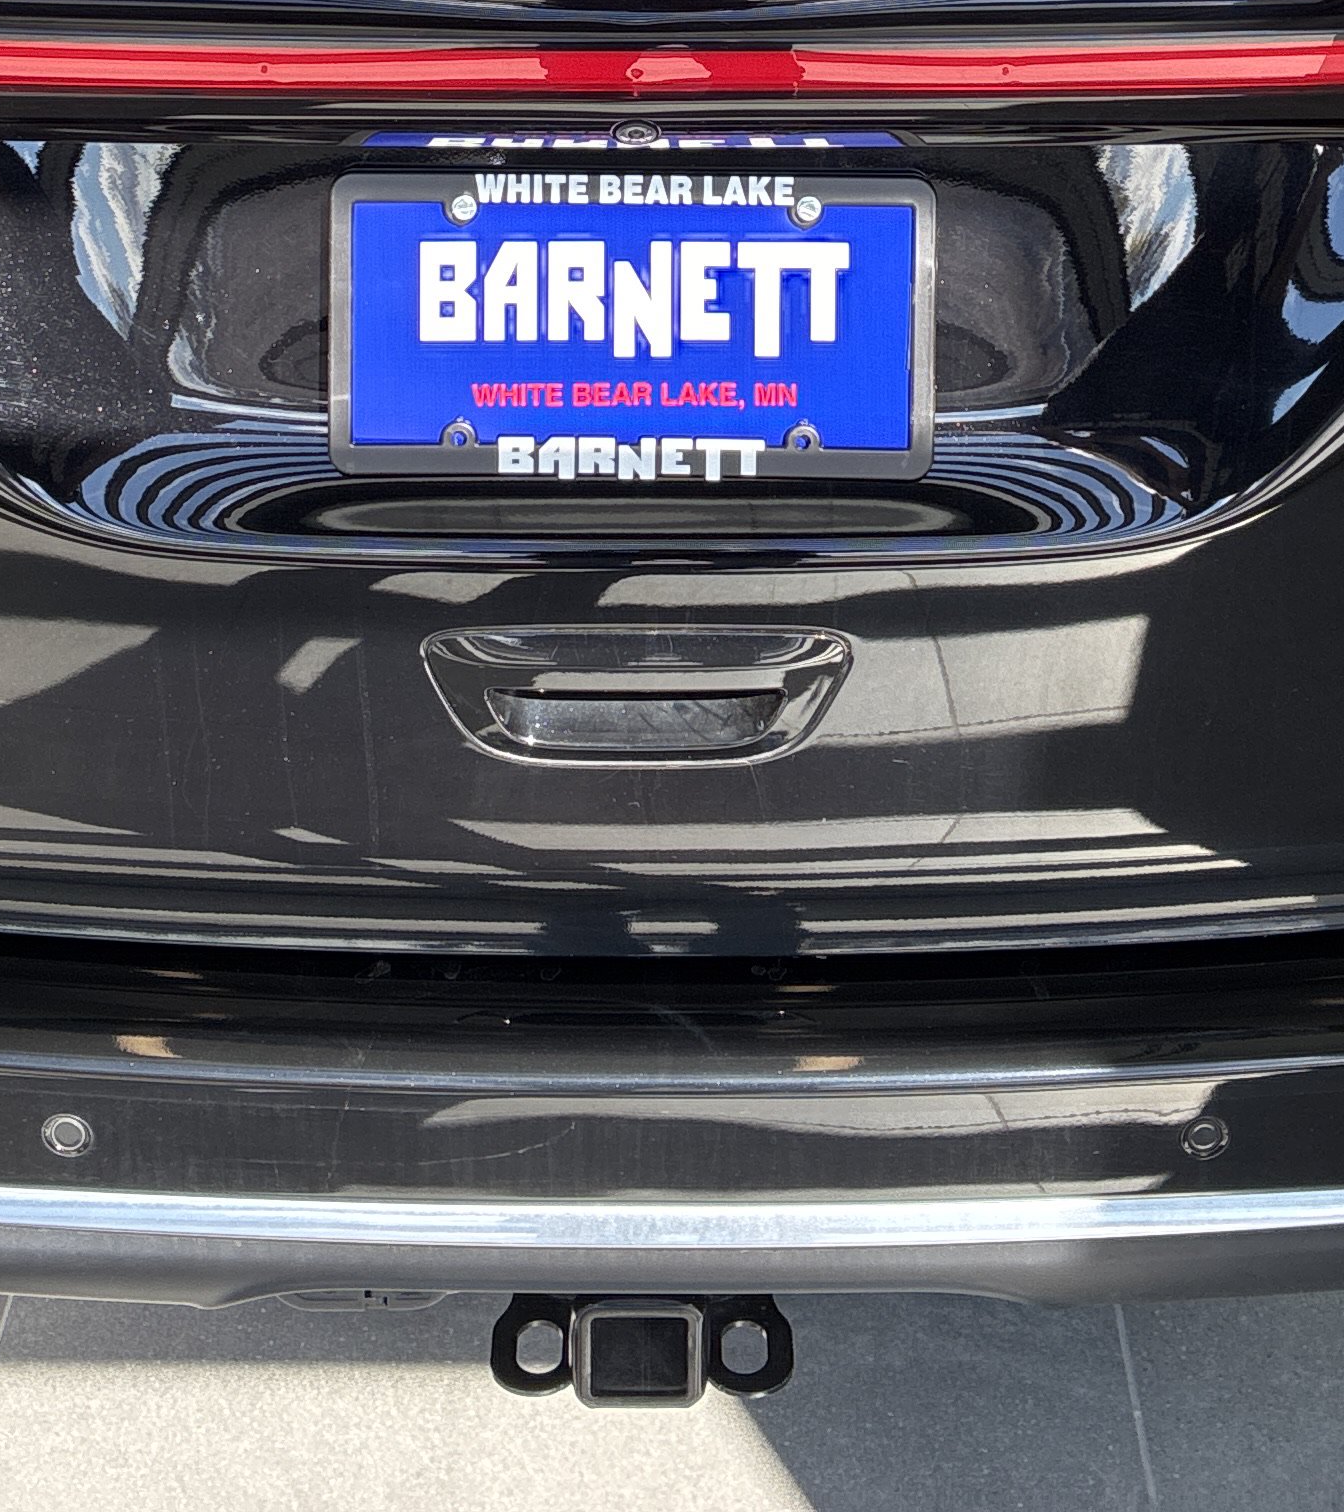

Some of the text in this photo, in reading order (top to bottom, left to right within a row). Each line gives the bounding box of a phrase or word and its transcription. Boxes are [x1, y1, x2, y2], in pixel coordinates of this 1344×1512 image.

[475, 174, 796, 207] WHITE BEAR LAKE
[419, 240, 851, 358] BARNETT
[471, 381, 798, 410] WHITE BEAR LAKE, MN
[498, 436, 766, 481] BARNETT
